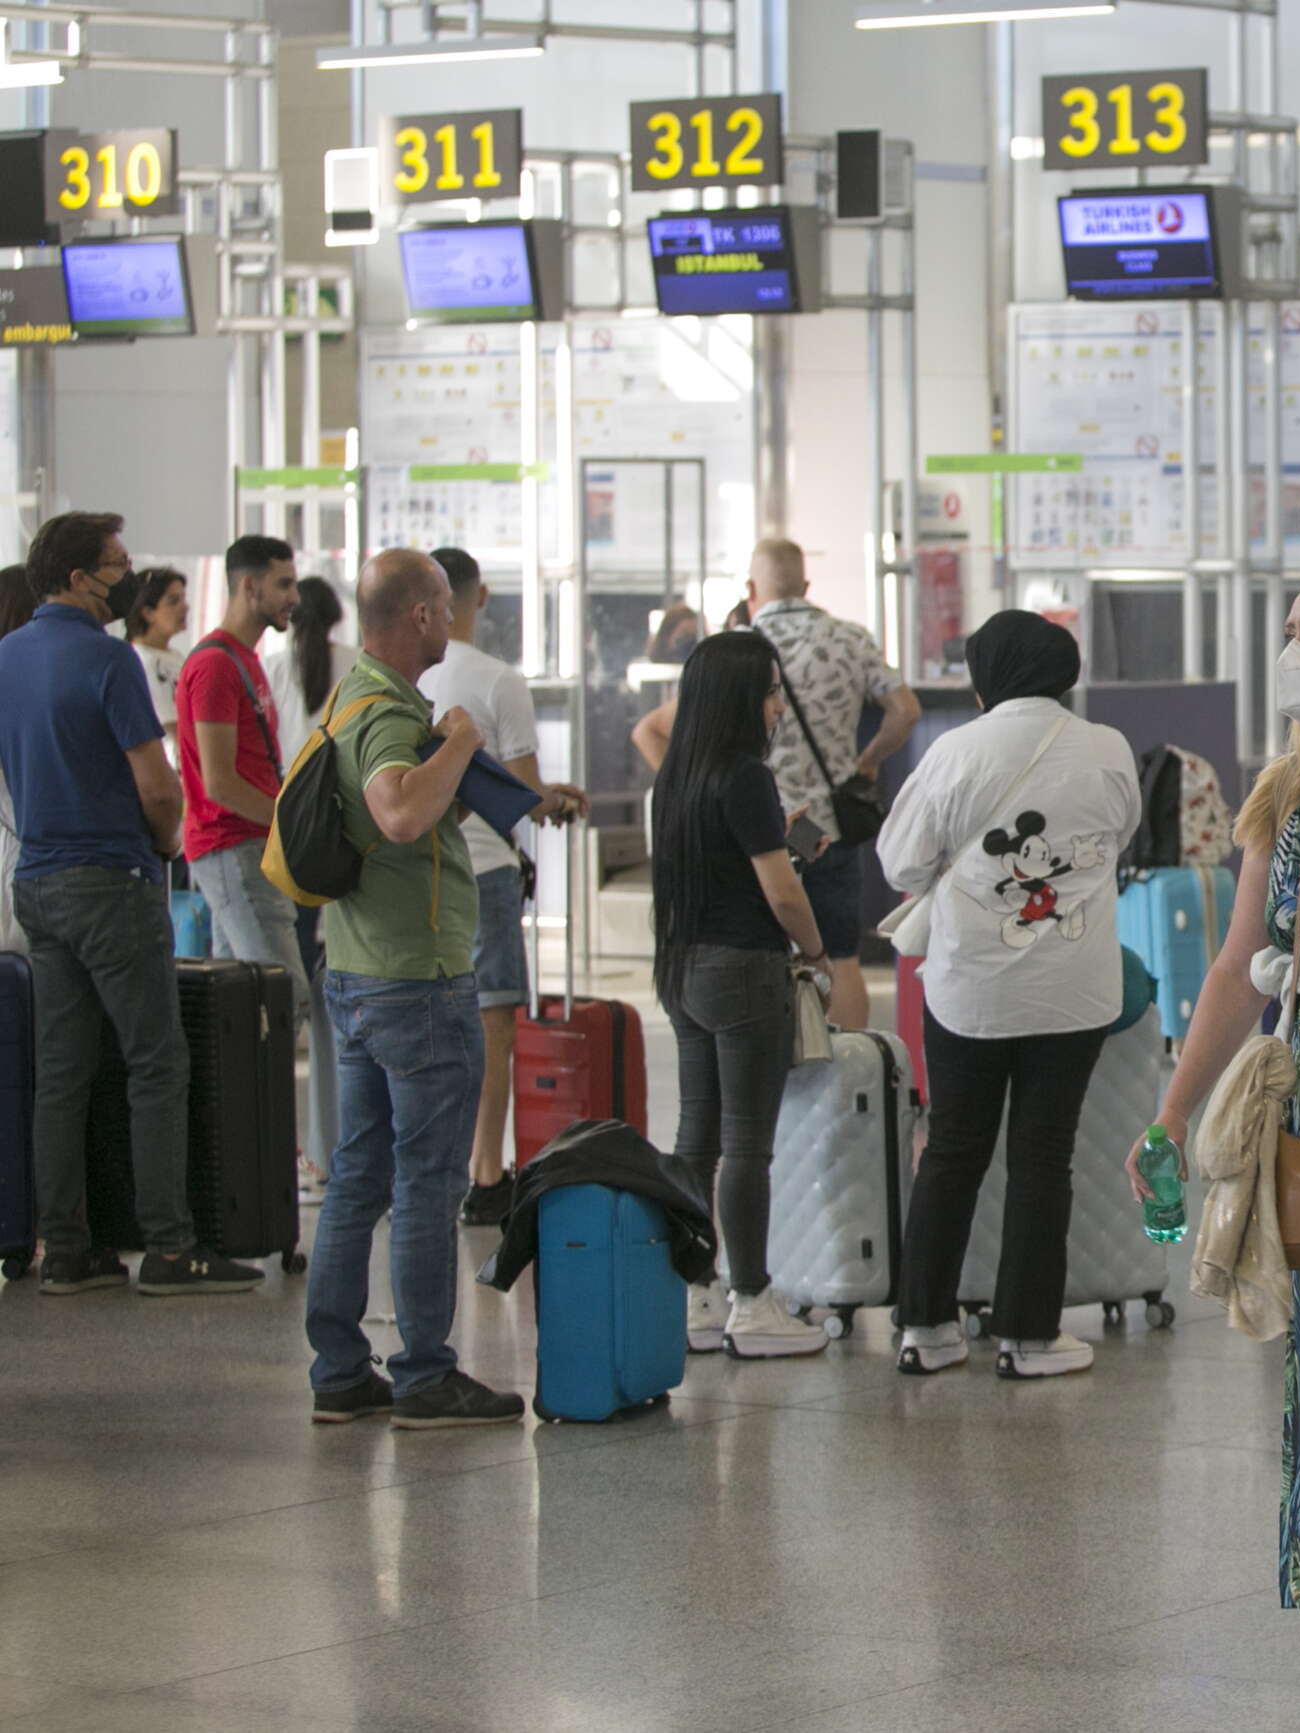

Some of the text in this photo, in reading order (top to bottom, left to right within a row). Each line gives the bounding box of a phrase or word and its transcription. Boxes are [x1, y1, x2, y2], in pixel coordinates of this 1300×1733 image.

[1058, 83, 1187, 158] 313
[645, 107, 764, 181] 312
[393, 120, 502, 193] 311
[58, 142, 162, 211] 310
[1082, 204, 1151, 220] TURKISH
[712, 226, 735, 243] TK
[1084, 221, 1152, 235] AIRLINES
[675, 252, 764, 275] ISTANBUL
[3, 322, 72, 344] embarqu
